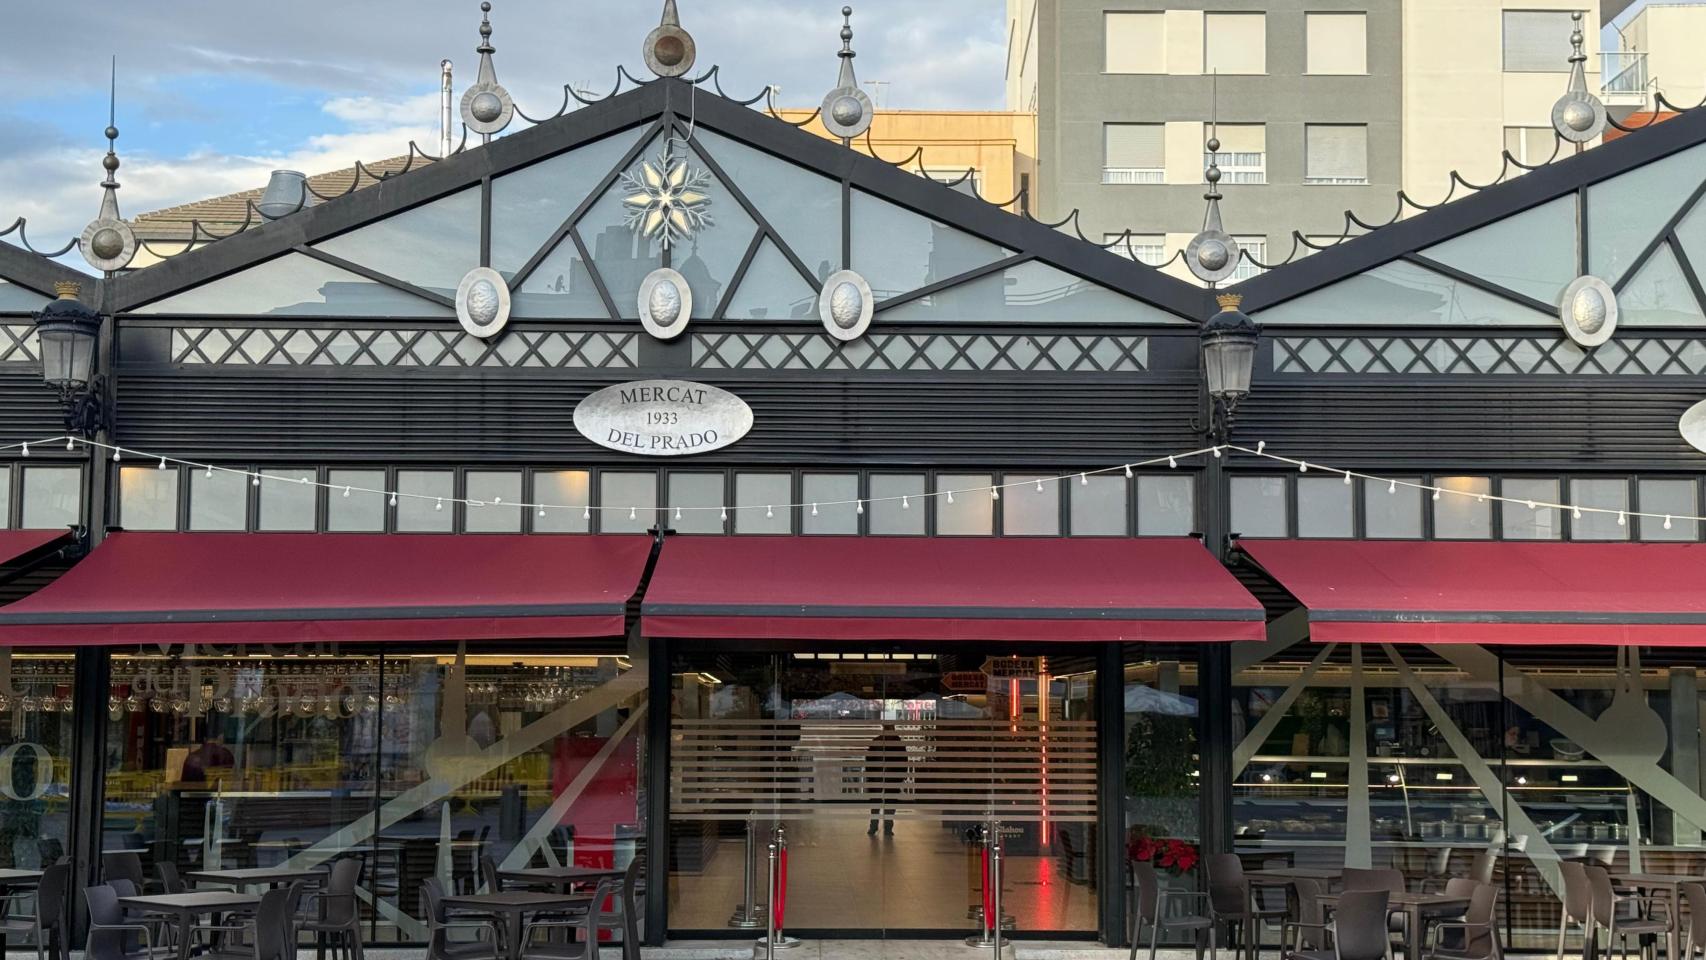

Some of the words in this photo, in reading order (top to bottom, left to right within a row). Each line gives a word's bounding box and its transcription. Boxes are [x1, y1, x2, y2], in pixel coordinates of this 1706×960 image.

[620, 387, 707, 405] MERCAT
[647, 412, 678, 425] 1933
[607, 428, 645, 449] DEL
[651, 429, 718, 449] PRADO
[993, 660, 1034, 668] BODEGA
